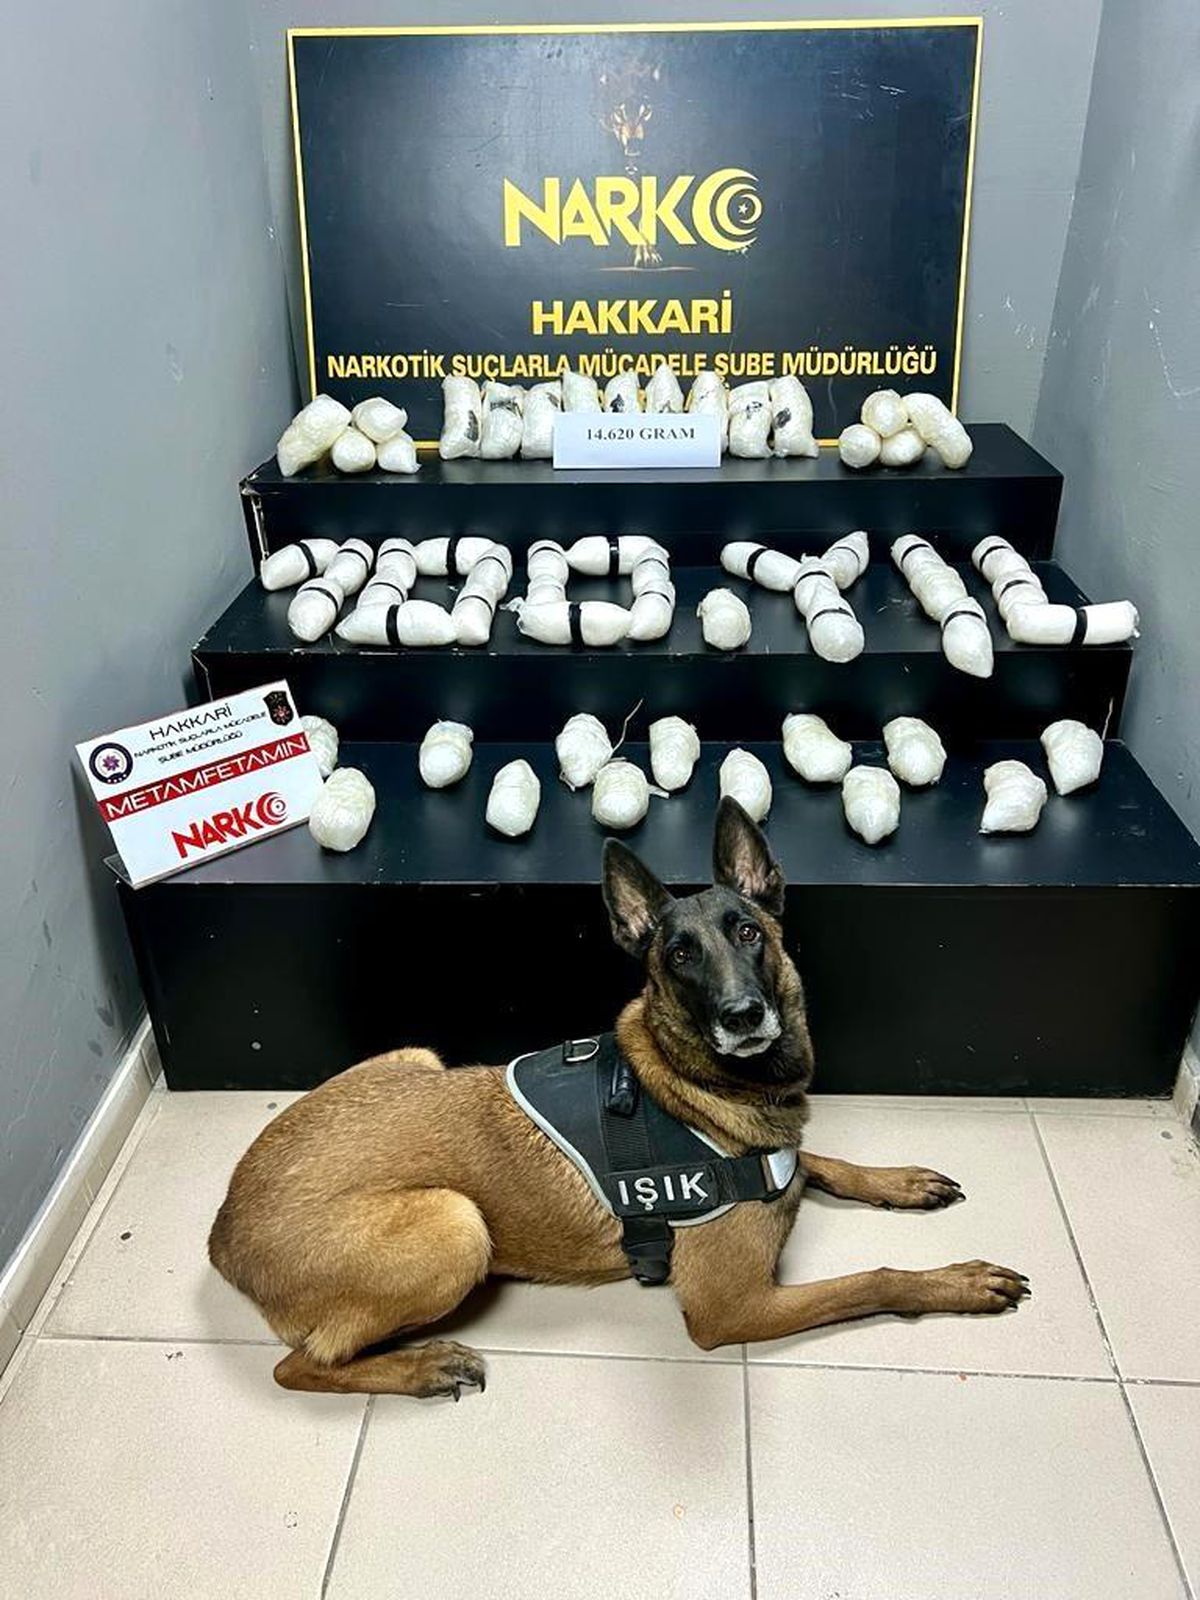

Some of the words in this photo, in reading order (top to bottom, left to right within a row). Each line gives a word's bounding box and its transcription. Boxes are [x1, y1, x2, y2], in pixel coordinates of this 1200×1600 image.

[532, 290, 732, 335] HAKKARİ
[328, 349, 445, 377] NARKOTİK
[452, 354, 570, 382] SUÇLARLA
[782, 345, 937, 376] MÜDÜRLÜĞÜ
[587, 428, 634, 440] 14.620
[639, 427, 695, 440] GRAM
[149, 702, 232, 740] HAKKARİ
[618, 1171, 709, 1210] IŞIK
